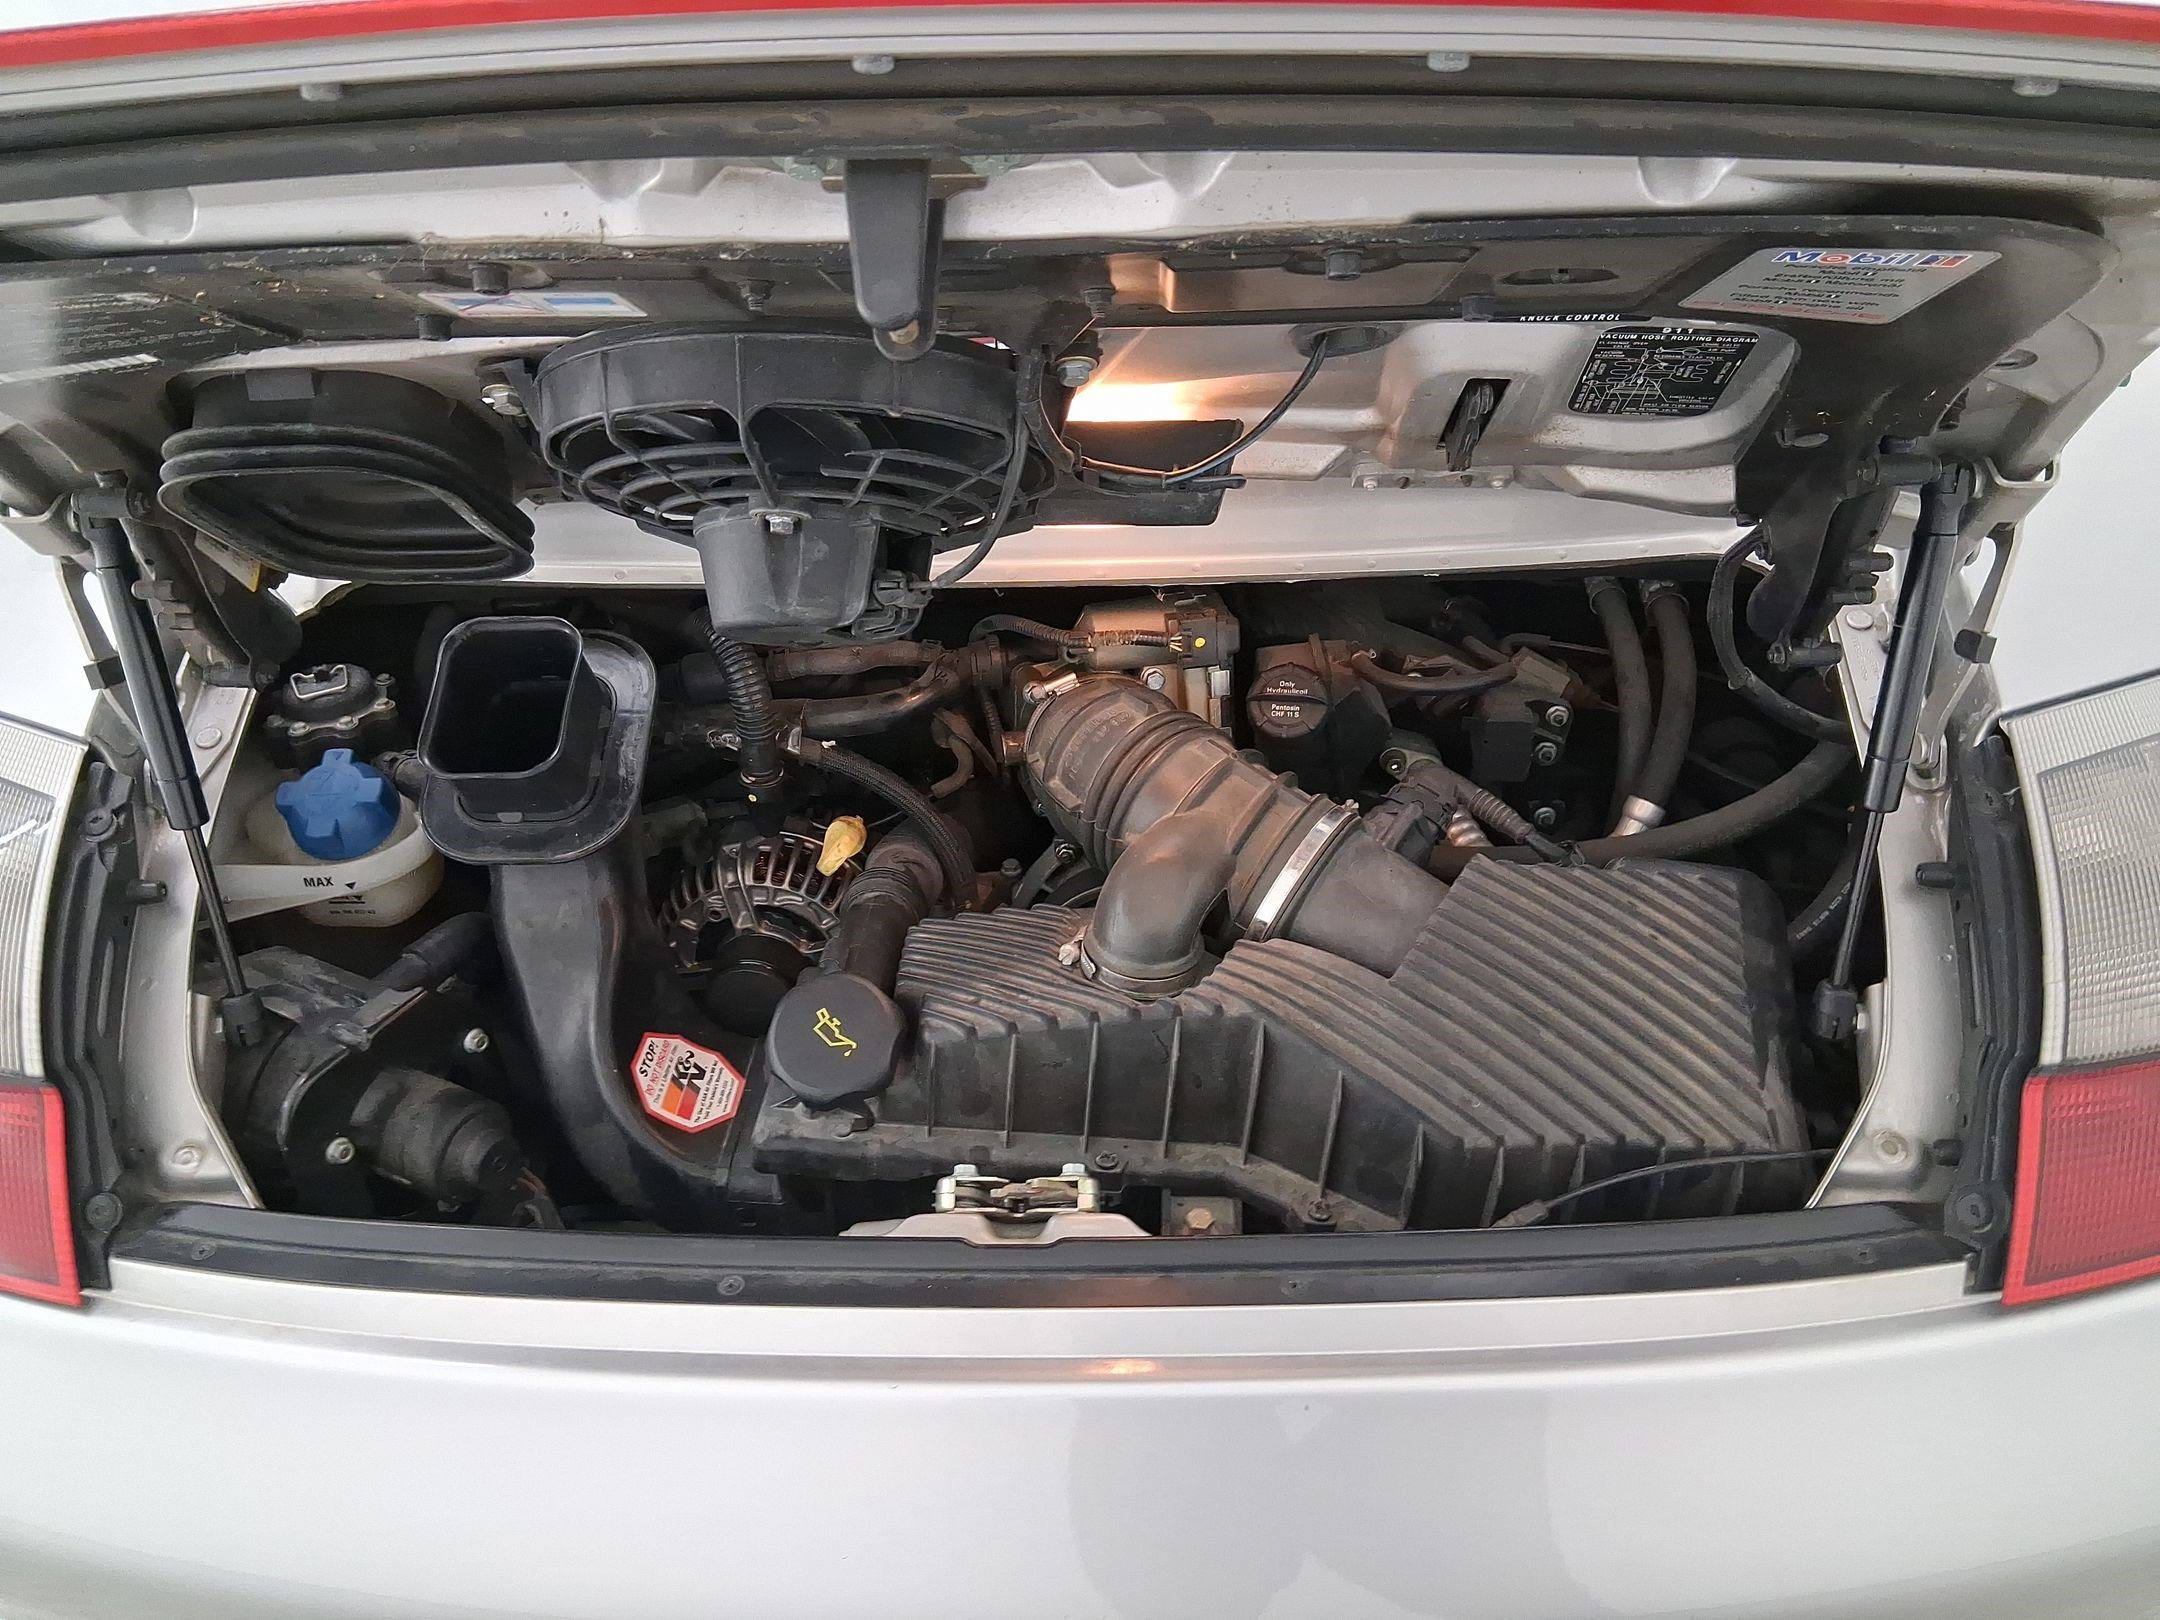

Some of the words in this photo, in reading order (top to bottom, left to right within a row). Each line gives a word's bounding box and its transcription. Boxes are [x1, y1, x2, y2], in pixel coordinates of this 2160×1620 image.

[1772, 251, 1919, 265] Mobil
[303, 877, 334, 887] MAX
[639, 1040, 659, 1077] STOP!
[650, 1068, 661, 1084] NOT
[658, 1040, 670, 1069] DISCARD
[671, 1050, 707, 1093] K&N
